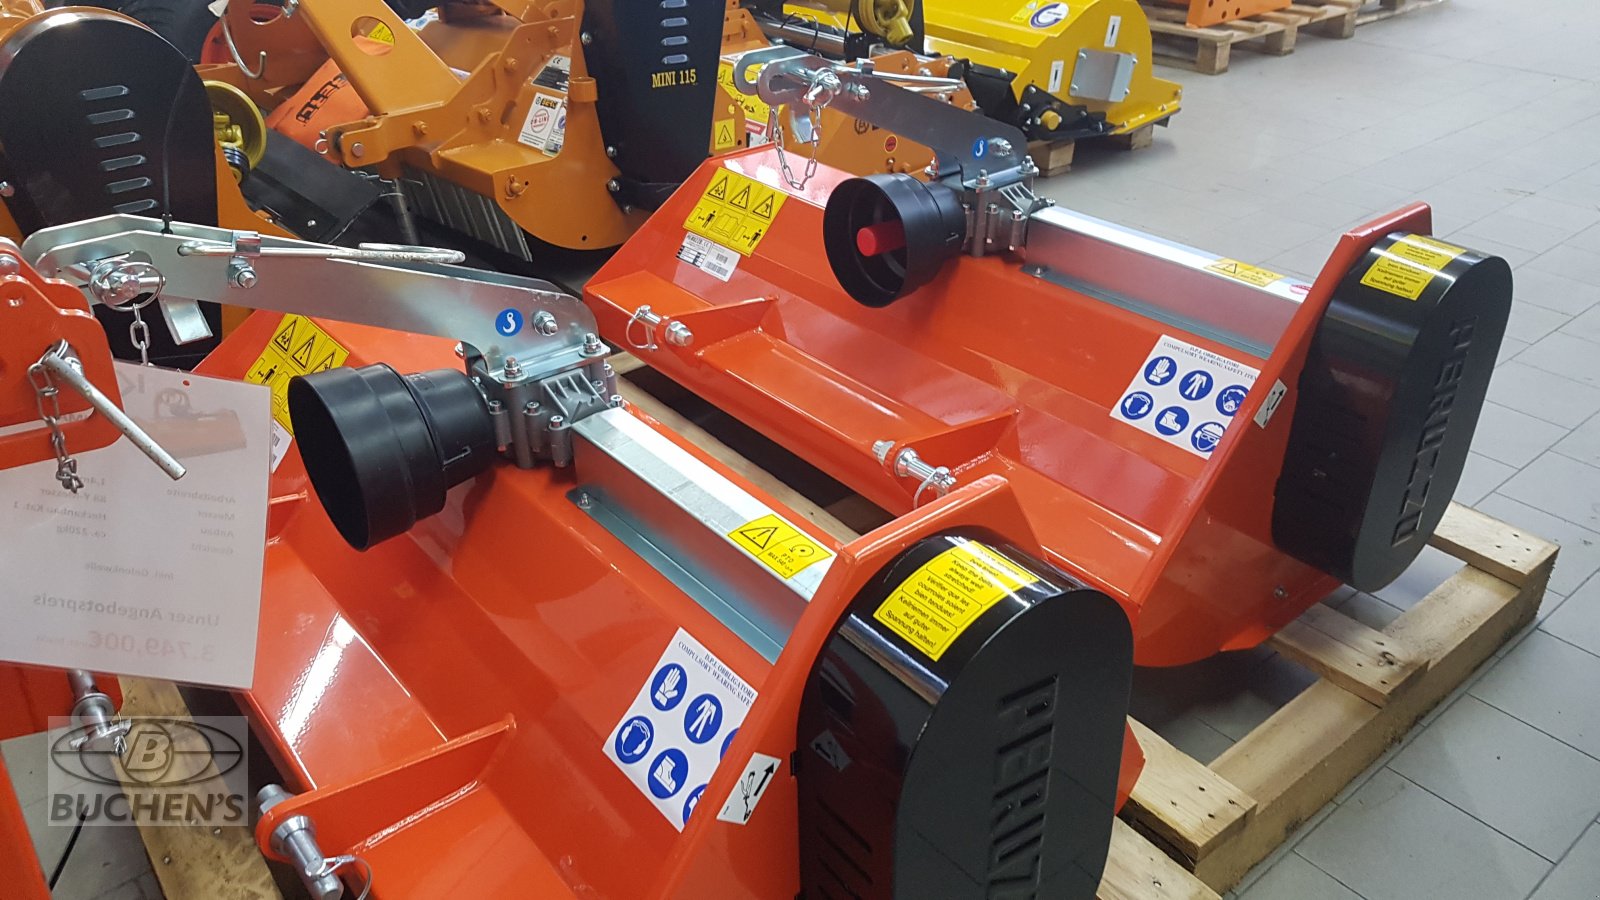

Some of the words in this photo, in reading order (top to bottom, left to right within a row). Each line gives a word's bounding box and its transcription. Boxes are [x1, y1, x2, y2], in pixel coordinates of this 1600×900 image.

[652, 71, 676, 88] MINI
[680, 69, 697, 84] 115
[949, 567, 970, 582] always
[951, 559, 968, 572] Keep
[914, 588, 928, 601] bien
[947, 590, 960, 600] que
[960, 598, 970, 607] les
[899, 594, 930, 619] Keilriemen
[929, 618, 950, 632] immer
[945, 599, 966, 614] soient
[885, 609, 915, 635] Spannung
[914, 629, 937, 649] halten!
[903, 610, 916, 621] auf
[912, 618, 931, 632] guter
[678, 641, 712, 673] COMPULSORY
[712, 668, 738, 695] WEARING
[736, 692, 753, 707] SAFE
[718, 664, 755, 699] OBBLIGATORI
[985, 673, 1059, 900] PERUZ
